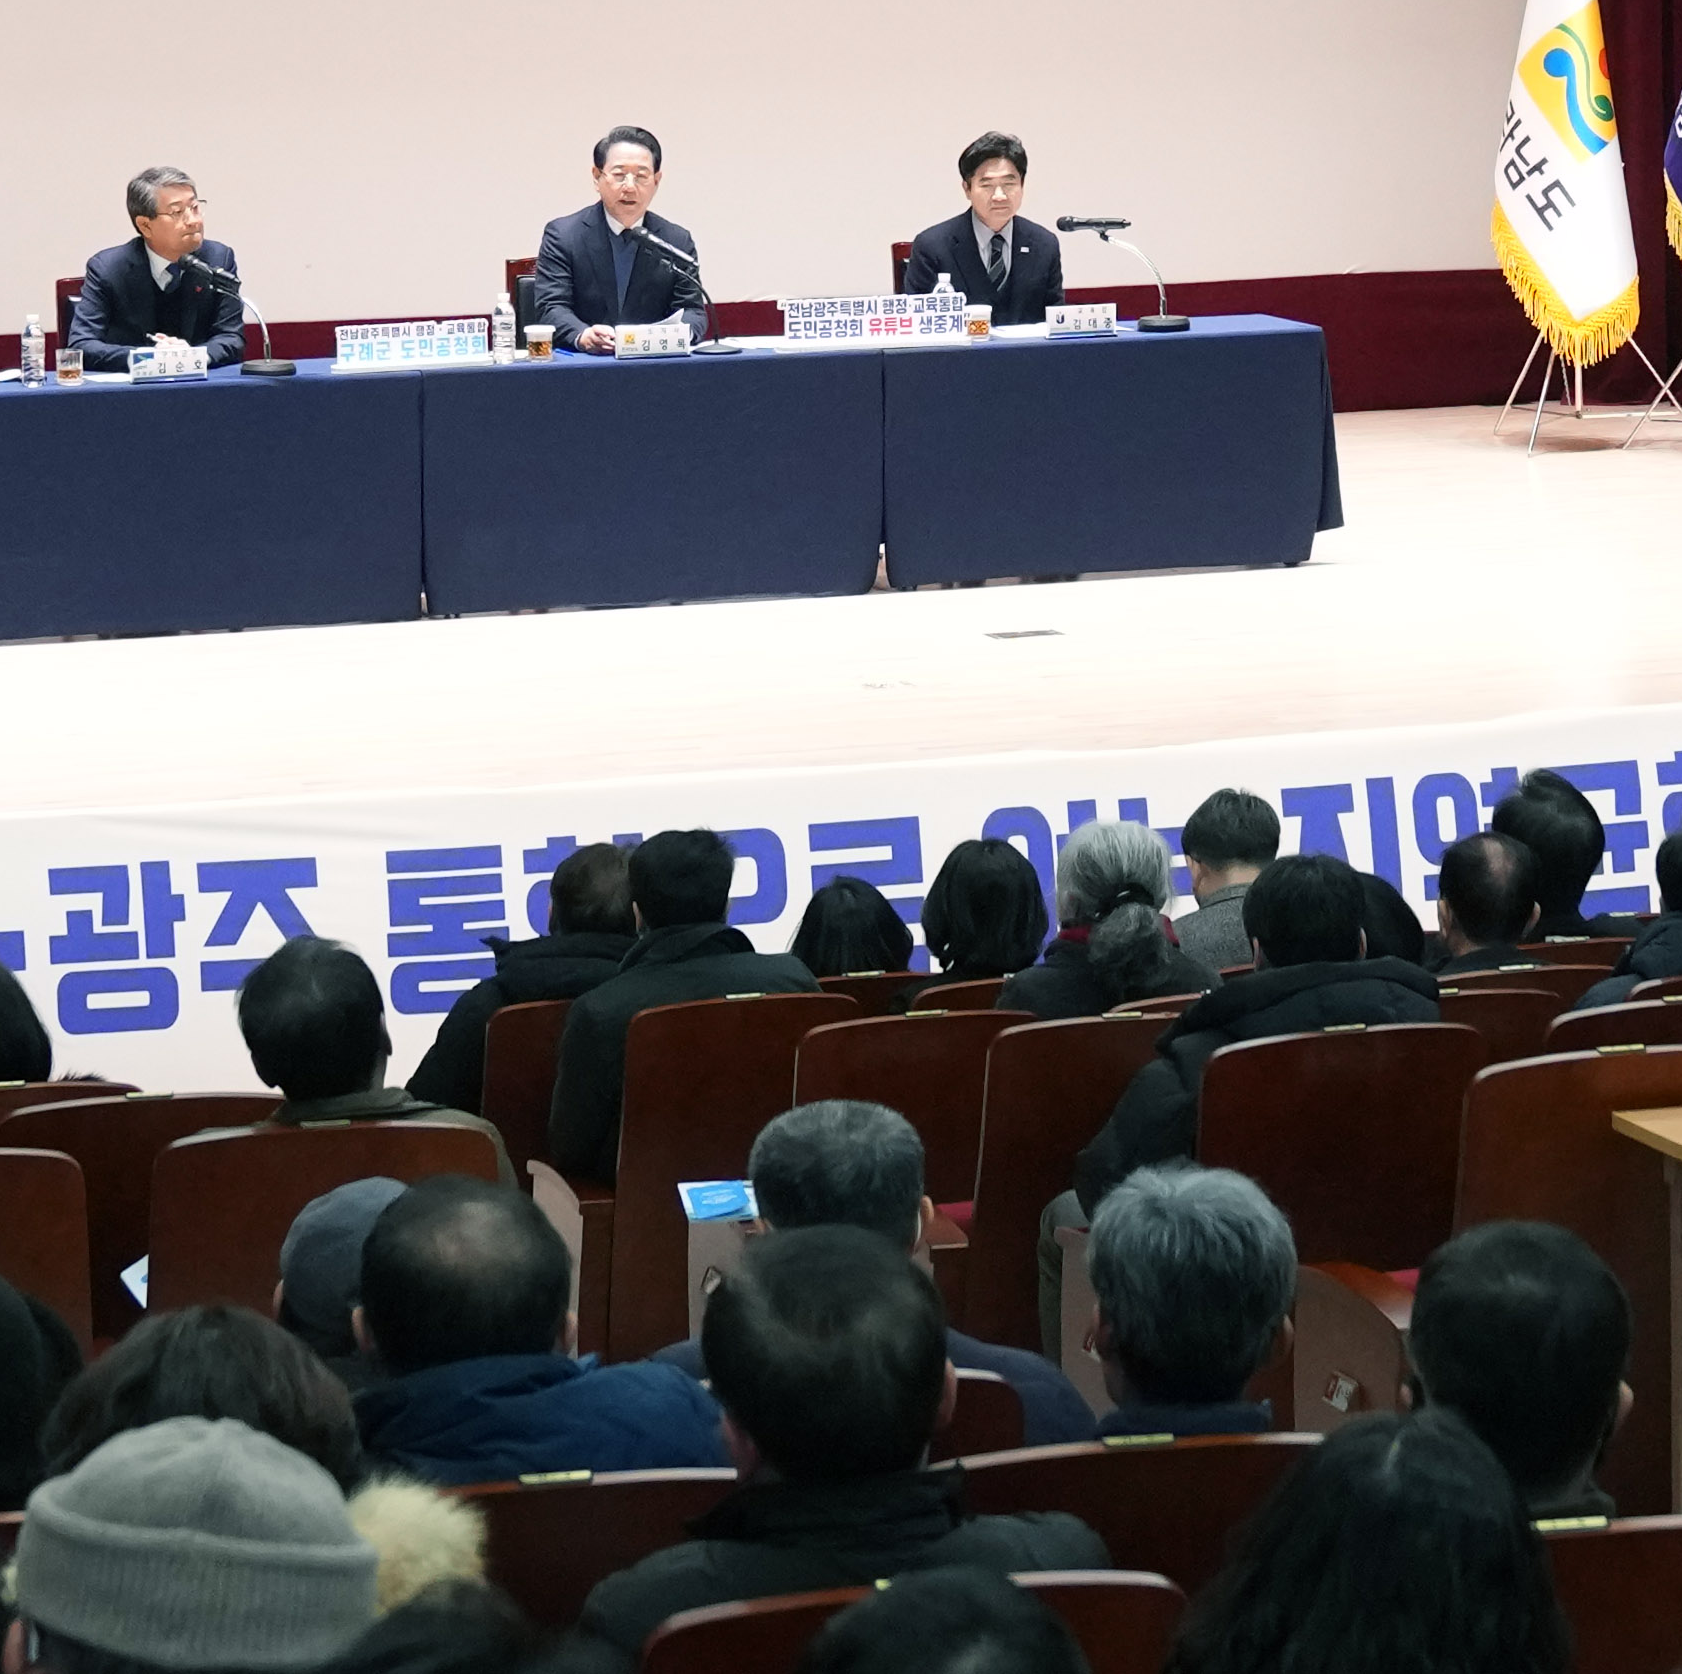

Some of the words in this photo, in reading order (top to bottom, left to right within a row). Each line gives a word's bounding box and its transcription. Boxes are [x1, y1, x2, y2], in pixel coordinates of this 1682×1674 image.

[339, 326, 411, 341] 전남광주특별시
[788, 318, 863, 340] 도민공청회
[868, 316, 913, 336] 유튜브
[340, 340, 391, 362] 구례군
[401, 335, 487, 359] 도민공청회
